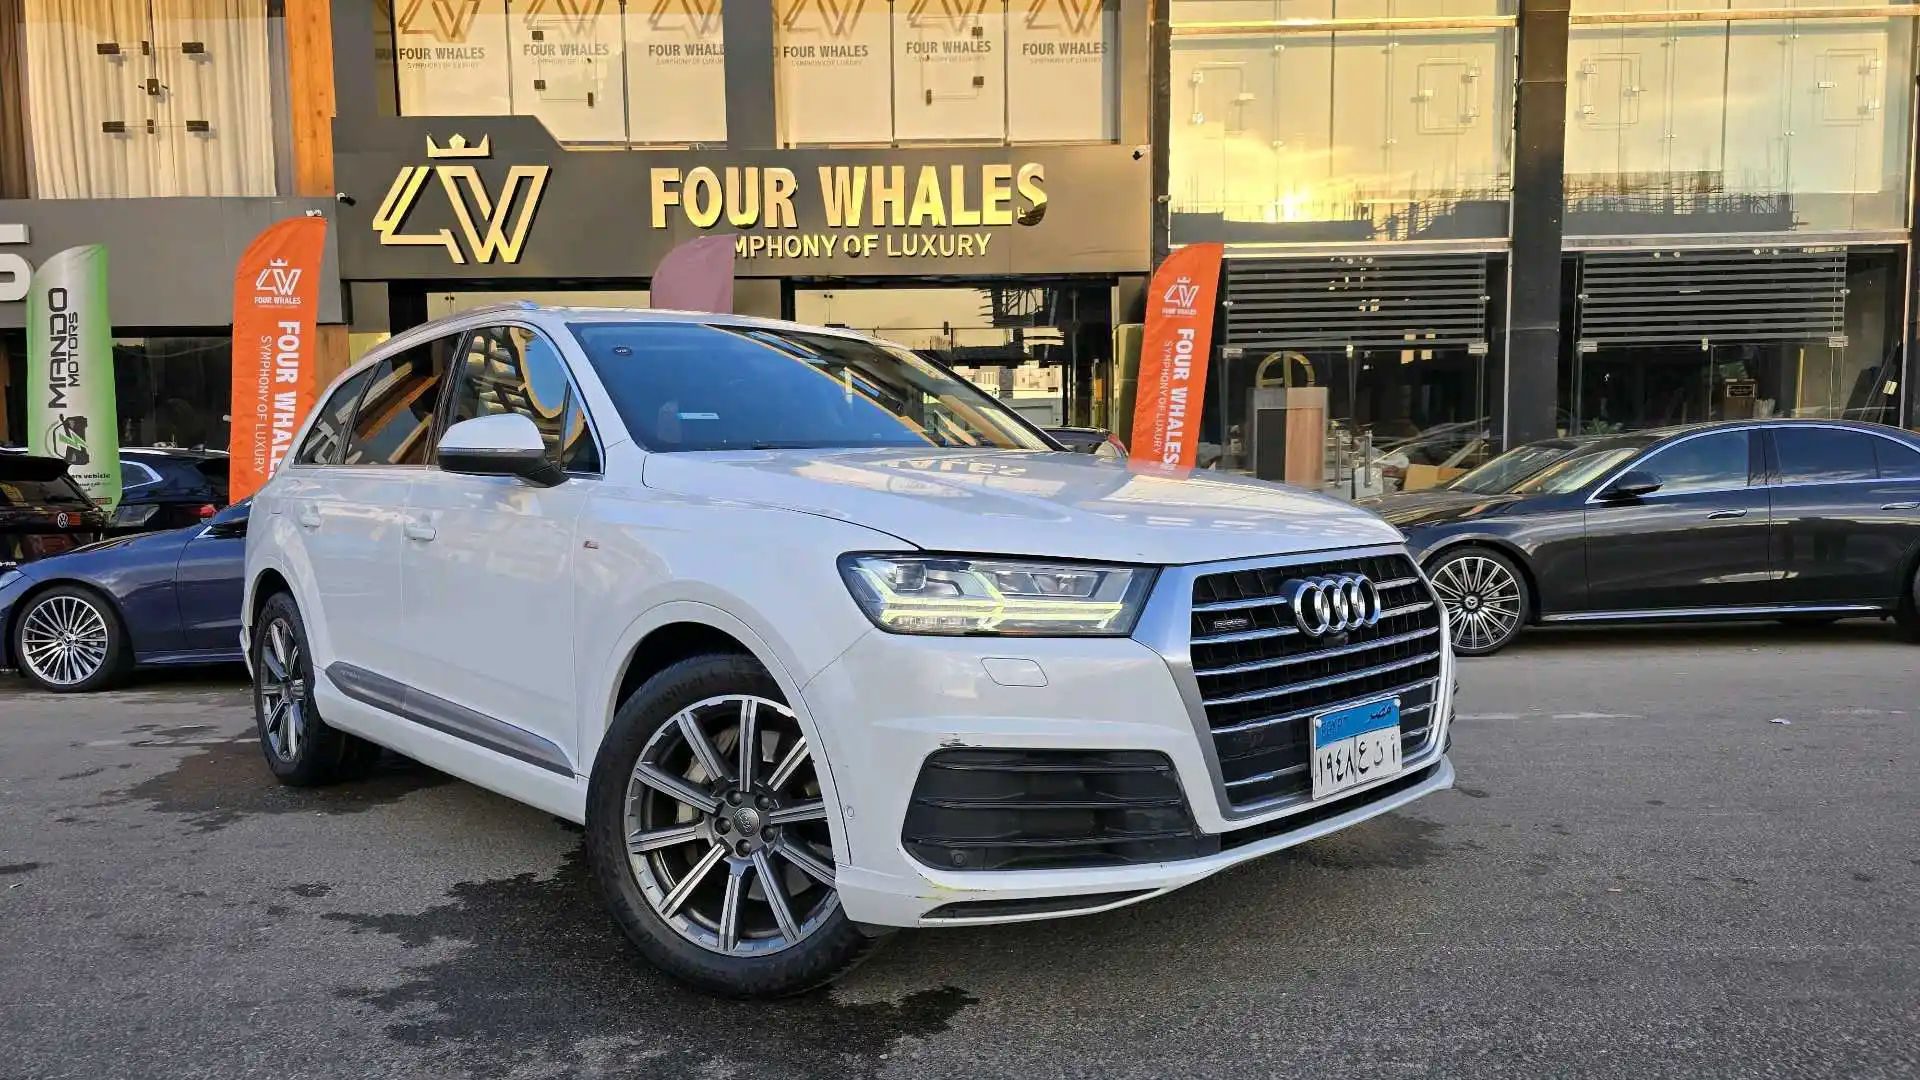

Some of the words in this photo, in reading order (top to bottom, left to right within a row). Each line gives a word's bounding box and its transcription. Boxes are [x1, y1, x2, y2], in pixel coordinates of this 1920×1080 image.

[399, 47, 432, 60] FOUR
[436, 46, 485, 60] WHALES
[523, 43, 555, 56] FOUR
[560, 43, 609, 56] WHALES
[648, 44, 680, 57] FOUR
[783, 46, 815, 58] FOUR
[819, 45, 868, 58] WHALES
[906, 41, 938, 54] FOUR
[942, 40, 991, 54] WHALES
[1022, 43, 1054, 55] FOUR
[1059, 41, 1108, 55] WHALES
[650, 165, 799, 230] FOUR
[821, 162, 1048, 228] WHALES
[735, 233, 836, 258] MPHONY
[843, 233, 879, 258] OF
[886, 232, 992, 258] LUXURY
[48, 286, 68, 409] MANDO
[68, 311, 80, 388] MOTORS
[257, 335, 273, 402] SYMPHONY
[276, 320, 300, 384] FOUR
[1160, 340, 1173, 396] SYMPHONY
[1172, 328, 1195, 381] FOUR
[256, 403, 269, 419] OF
[1152, 412, 1165, 457] LUXURY
[1163, 386, 1188, 465] WHALES
[253, 423, 269, 475] LUXURY
